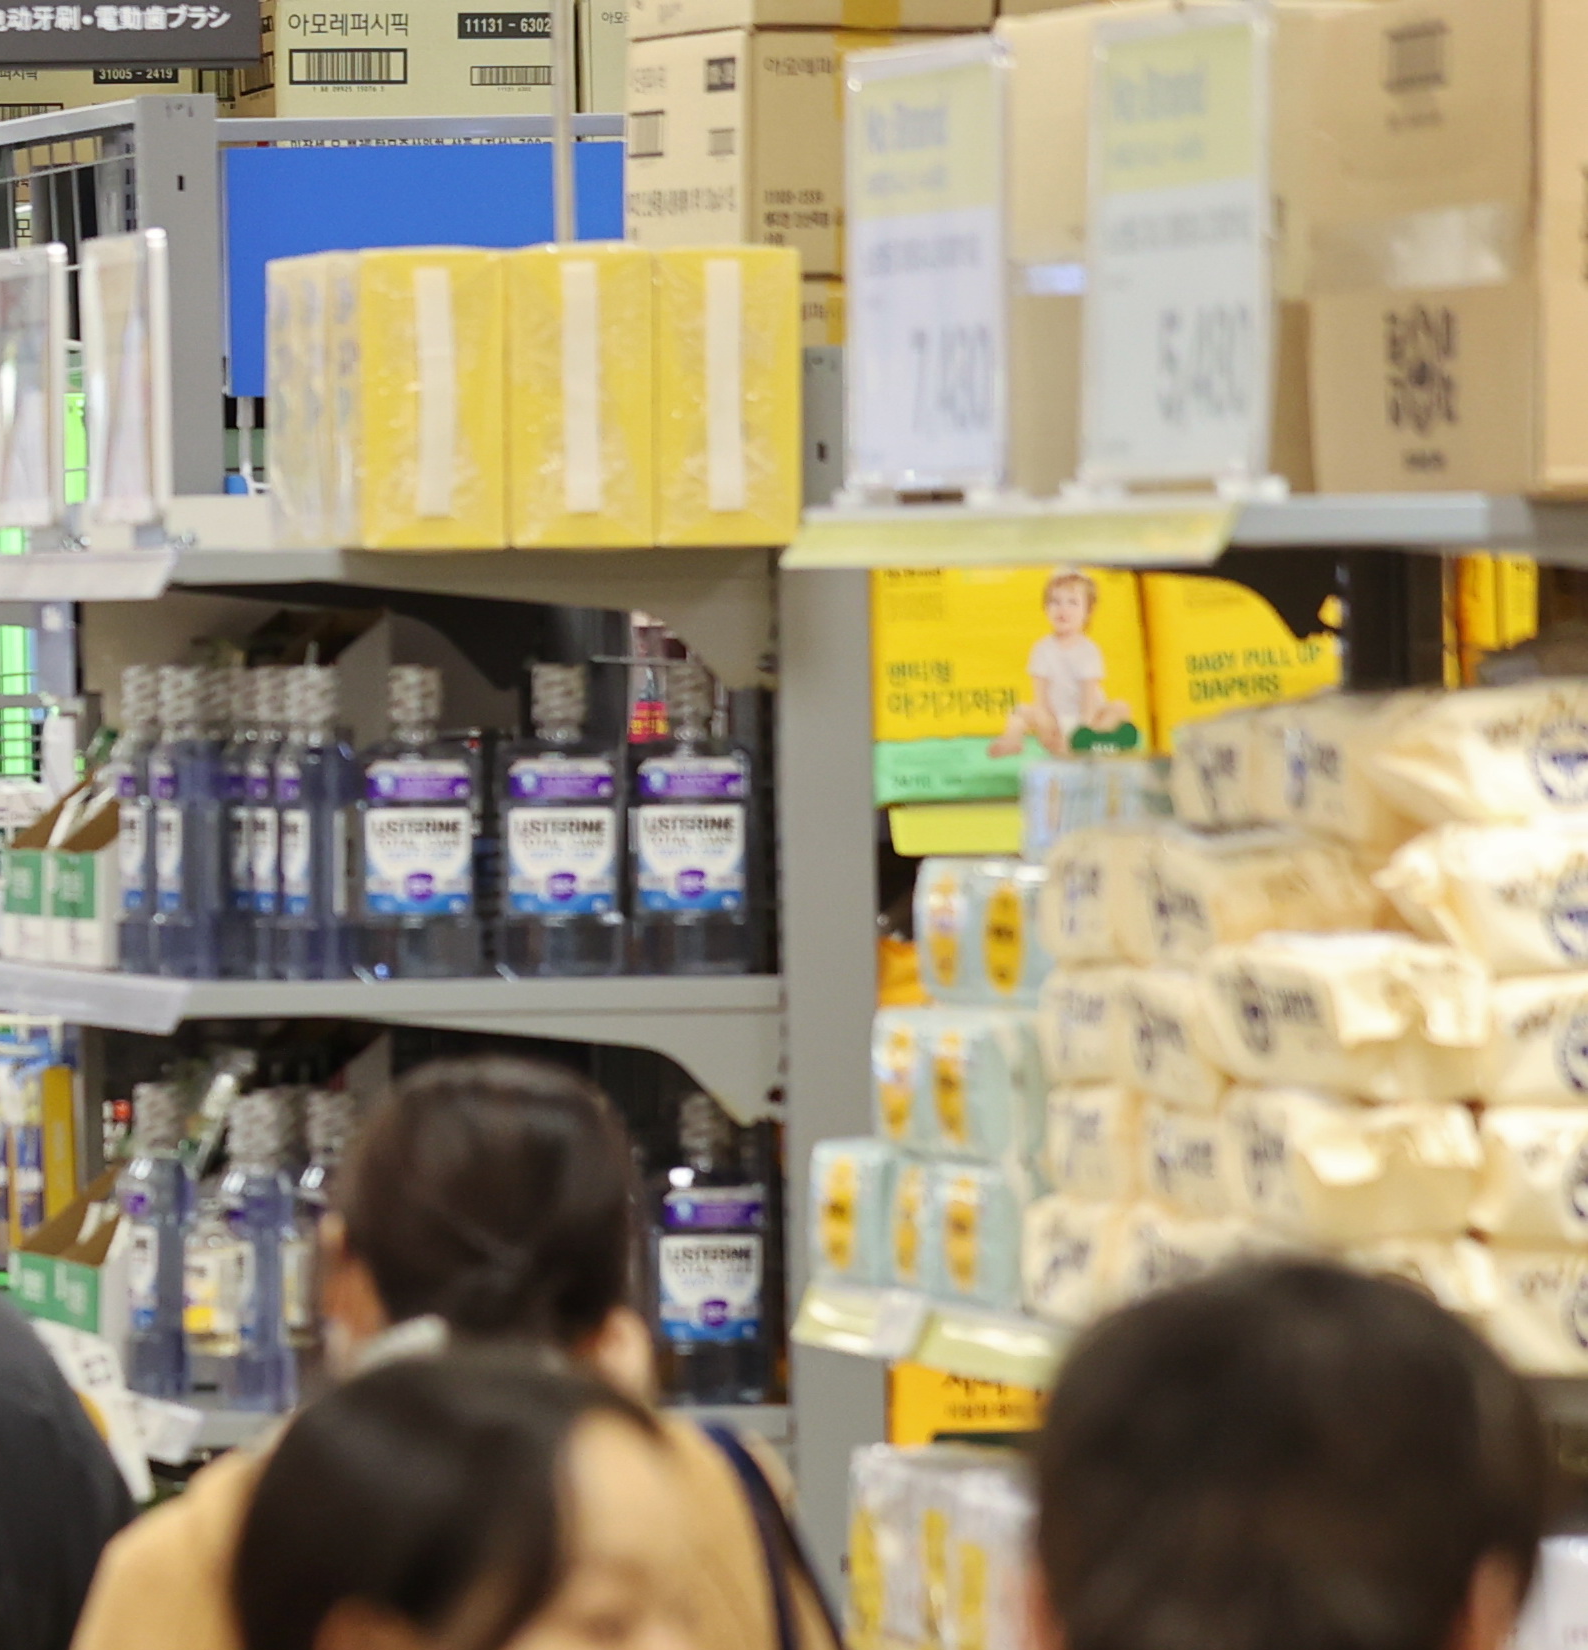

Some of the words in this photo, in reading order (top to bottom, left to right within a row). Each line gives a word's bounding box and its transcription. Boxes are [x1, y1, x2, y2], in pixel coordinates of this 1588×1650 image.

[95, 6, 231, 32] 電動歯ブラシ
[289, 13, 409, 37] 아모레퍼시픽
